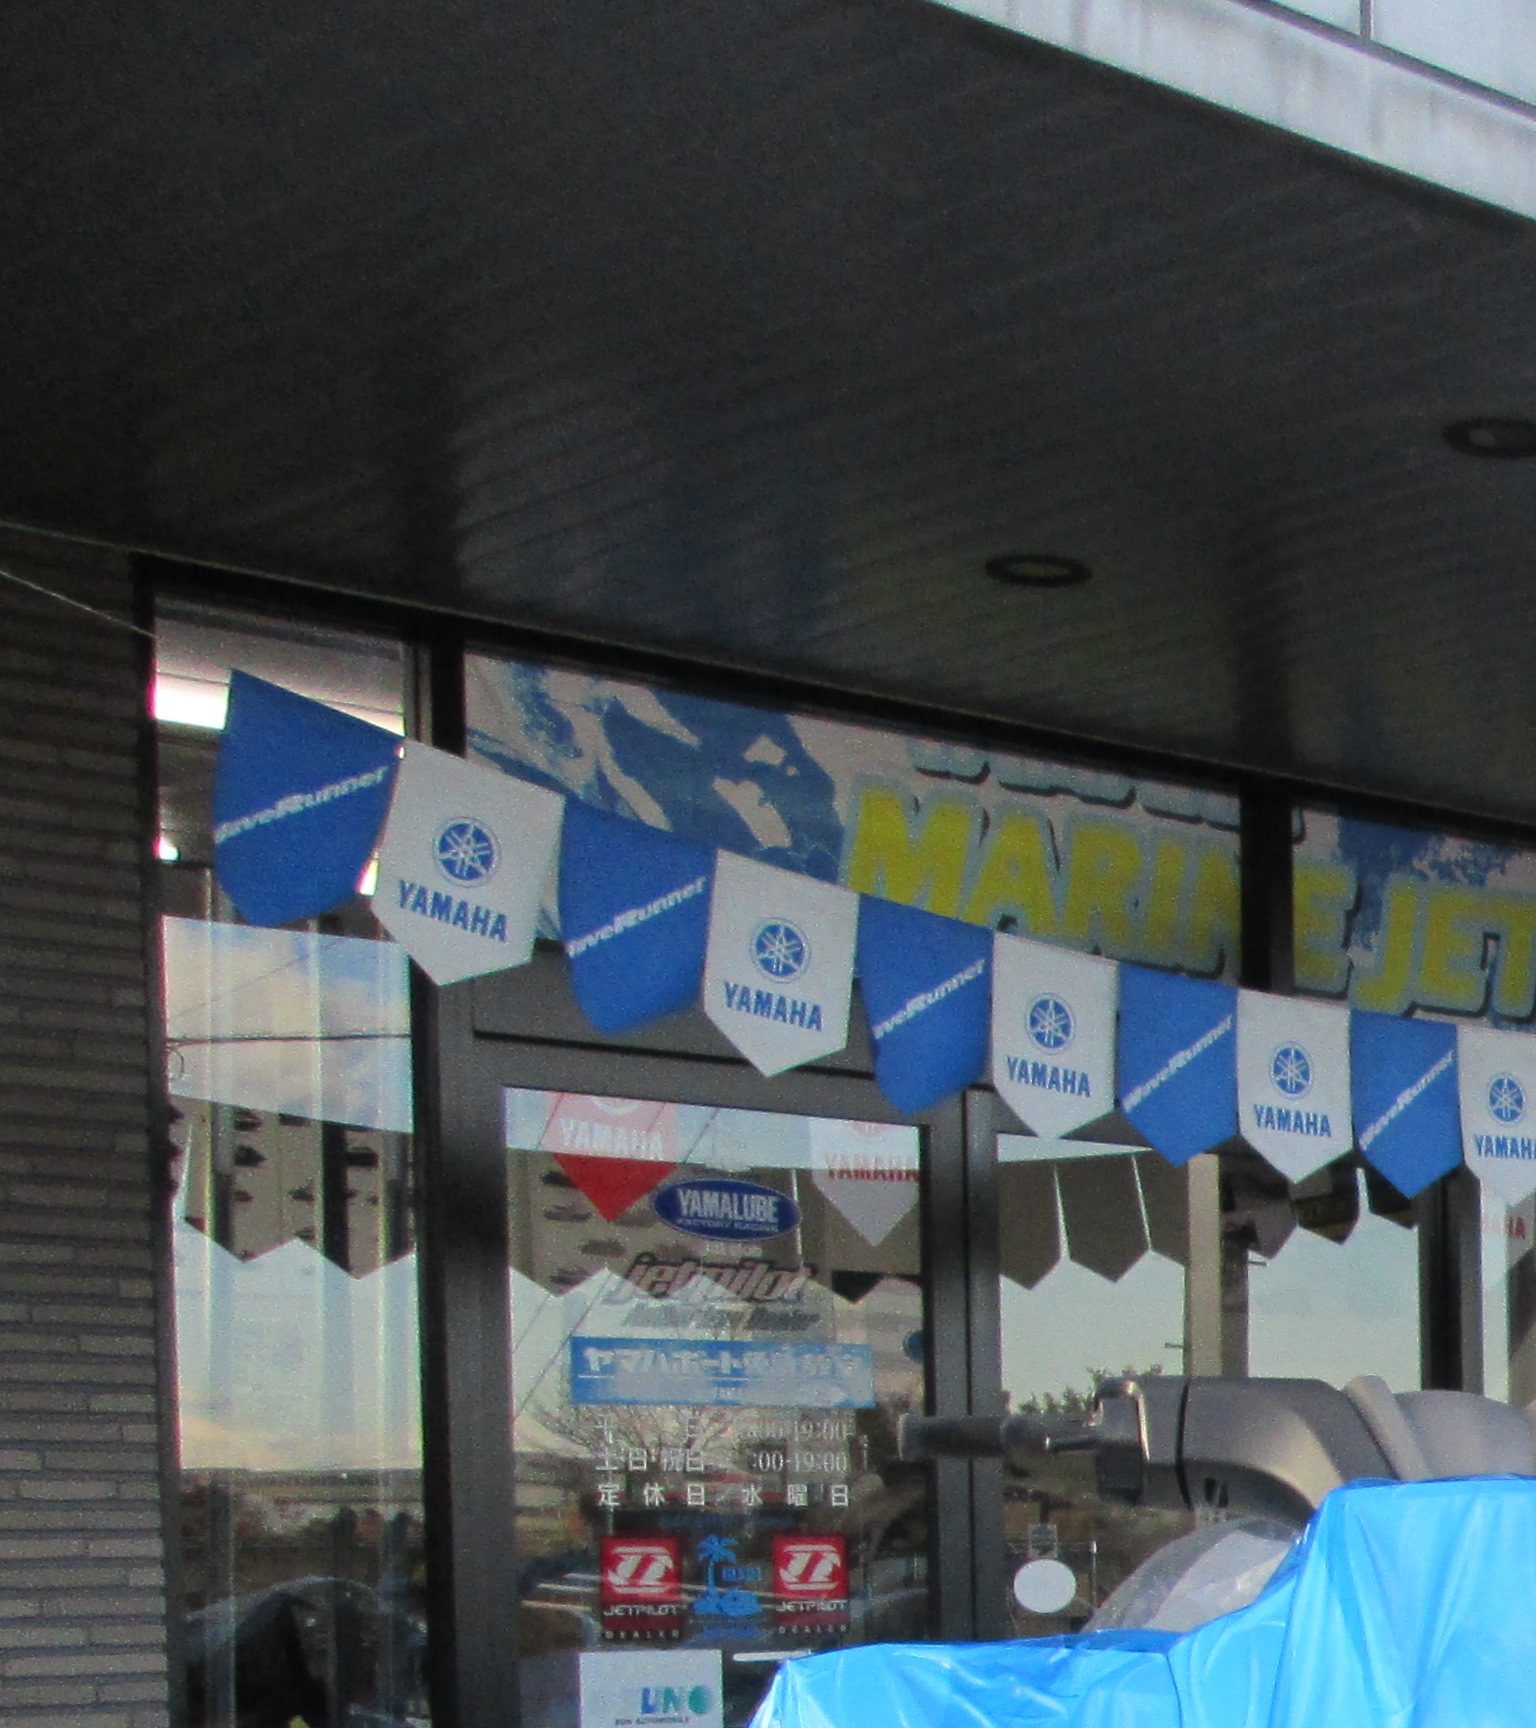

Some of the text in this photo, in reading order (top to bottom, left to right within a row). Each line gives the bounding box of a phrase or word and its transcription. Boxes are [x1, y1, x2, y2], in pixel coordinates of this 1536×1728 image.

[398, 879, 508, 942] YAMAHA
[723, 980, 823, 1032] YAMAHA
[1007, 1055, 1092, 1098] YAMAHA
[559, 1117, 664, 1160] YAMAHA
[1254, 1103, 1332, 1137] YAMAHA
[677, 1188, 780, 1224] YAMALUBE
[603, 1604, 678, 1617] JETPILOT
[775, 1599, 848, 1613] JETPILOT
